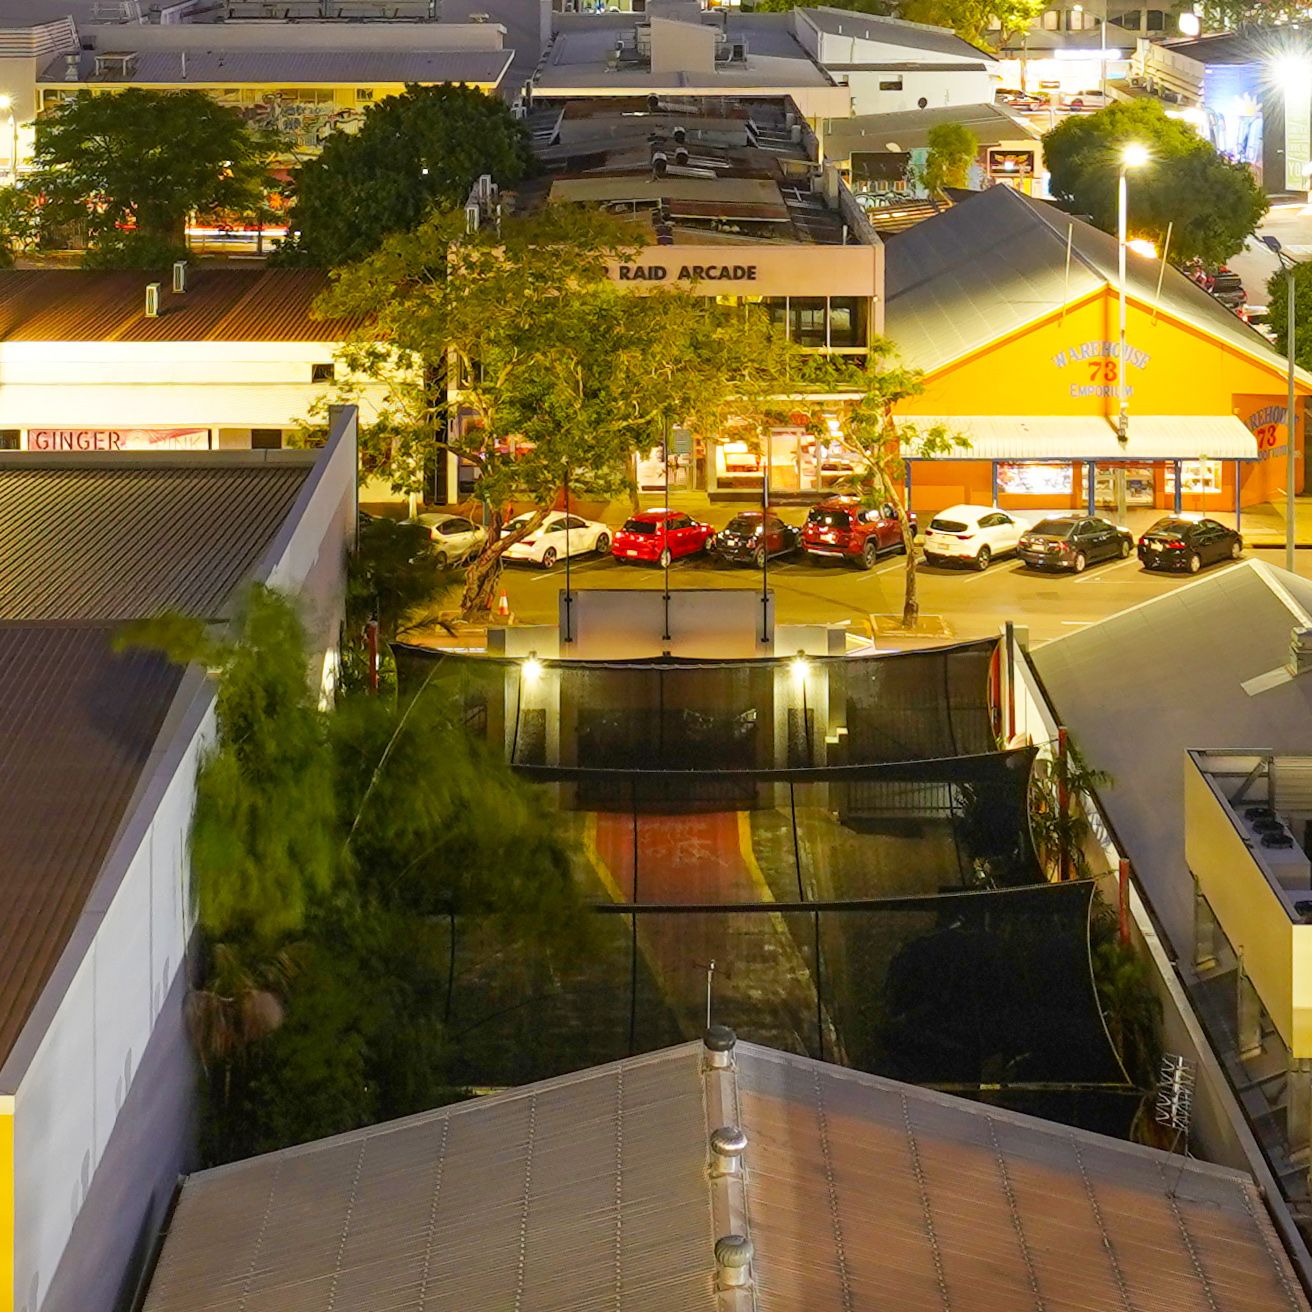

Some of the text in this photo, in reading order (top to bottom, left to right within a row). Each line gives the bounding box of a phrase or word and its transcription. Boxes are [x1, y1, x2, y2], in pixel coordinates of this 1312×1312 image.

[619, 265, 667, 281] RAID
[678, 265, 757, 281] ARCADE
[1051, 340, 1152, 370] WAREHOUSE
[1088, 361, 1118, 382] 73
[35, 431, 121, 451] GINGER
[1257, 424, 1277, 449] 73
